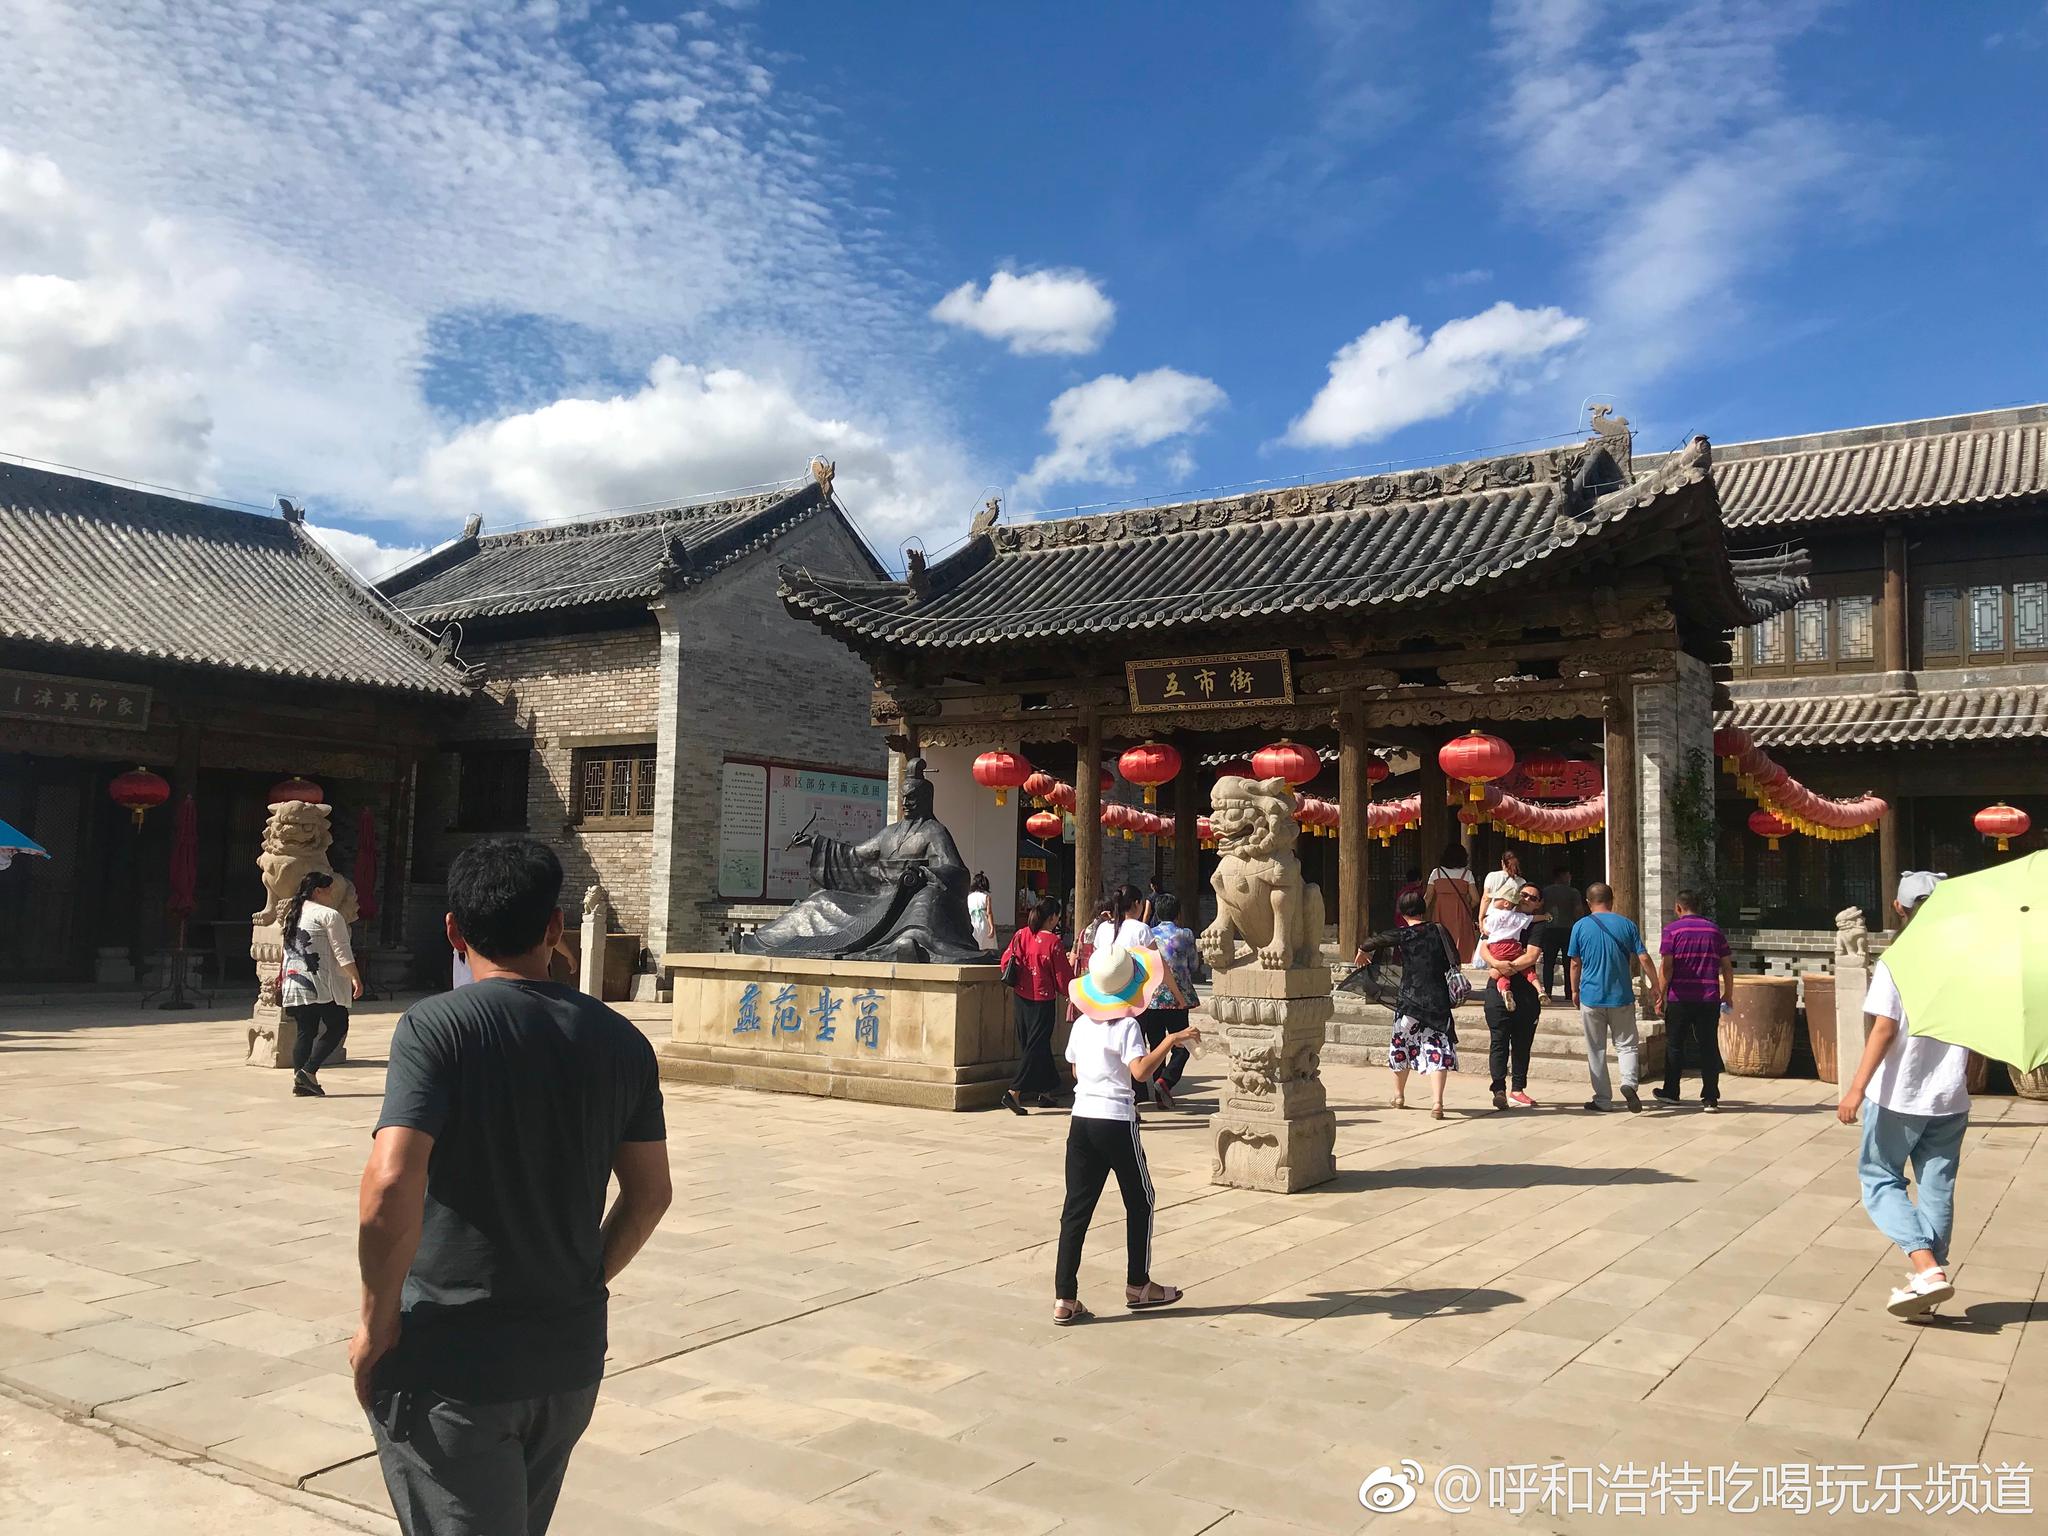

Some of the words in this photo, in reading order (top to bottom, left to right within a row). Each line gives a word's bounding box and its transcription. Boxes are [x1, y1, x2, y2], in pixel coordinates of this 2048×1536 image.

[1163, 667, 1254, 699] 互市街
[782, 774, 881, 798] 景区部分平面示意图
